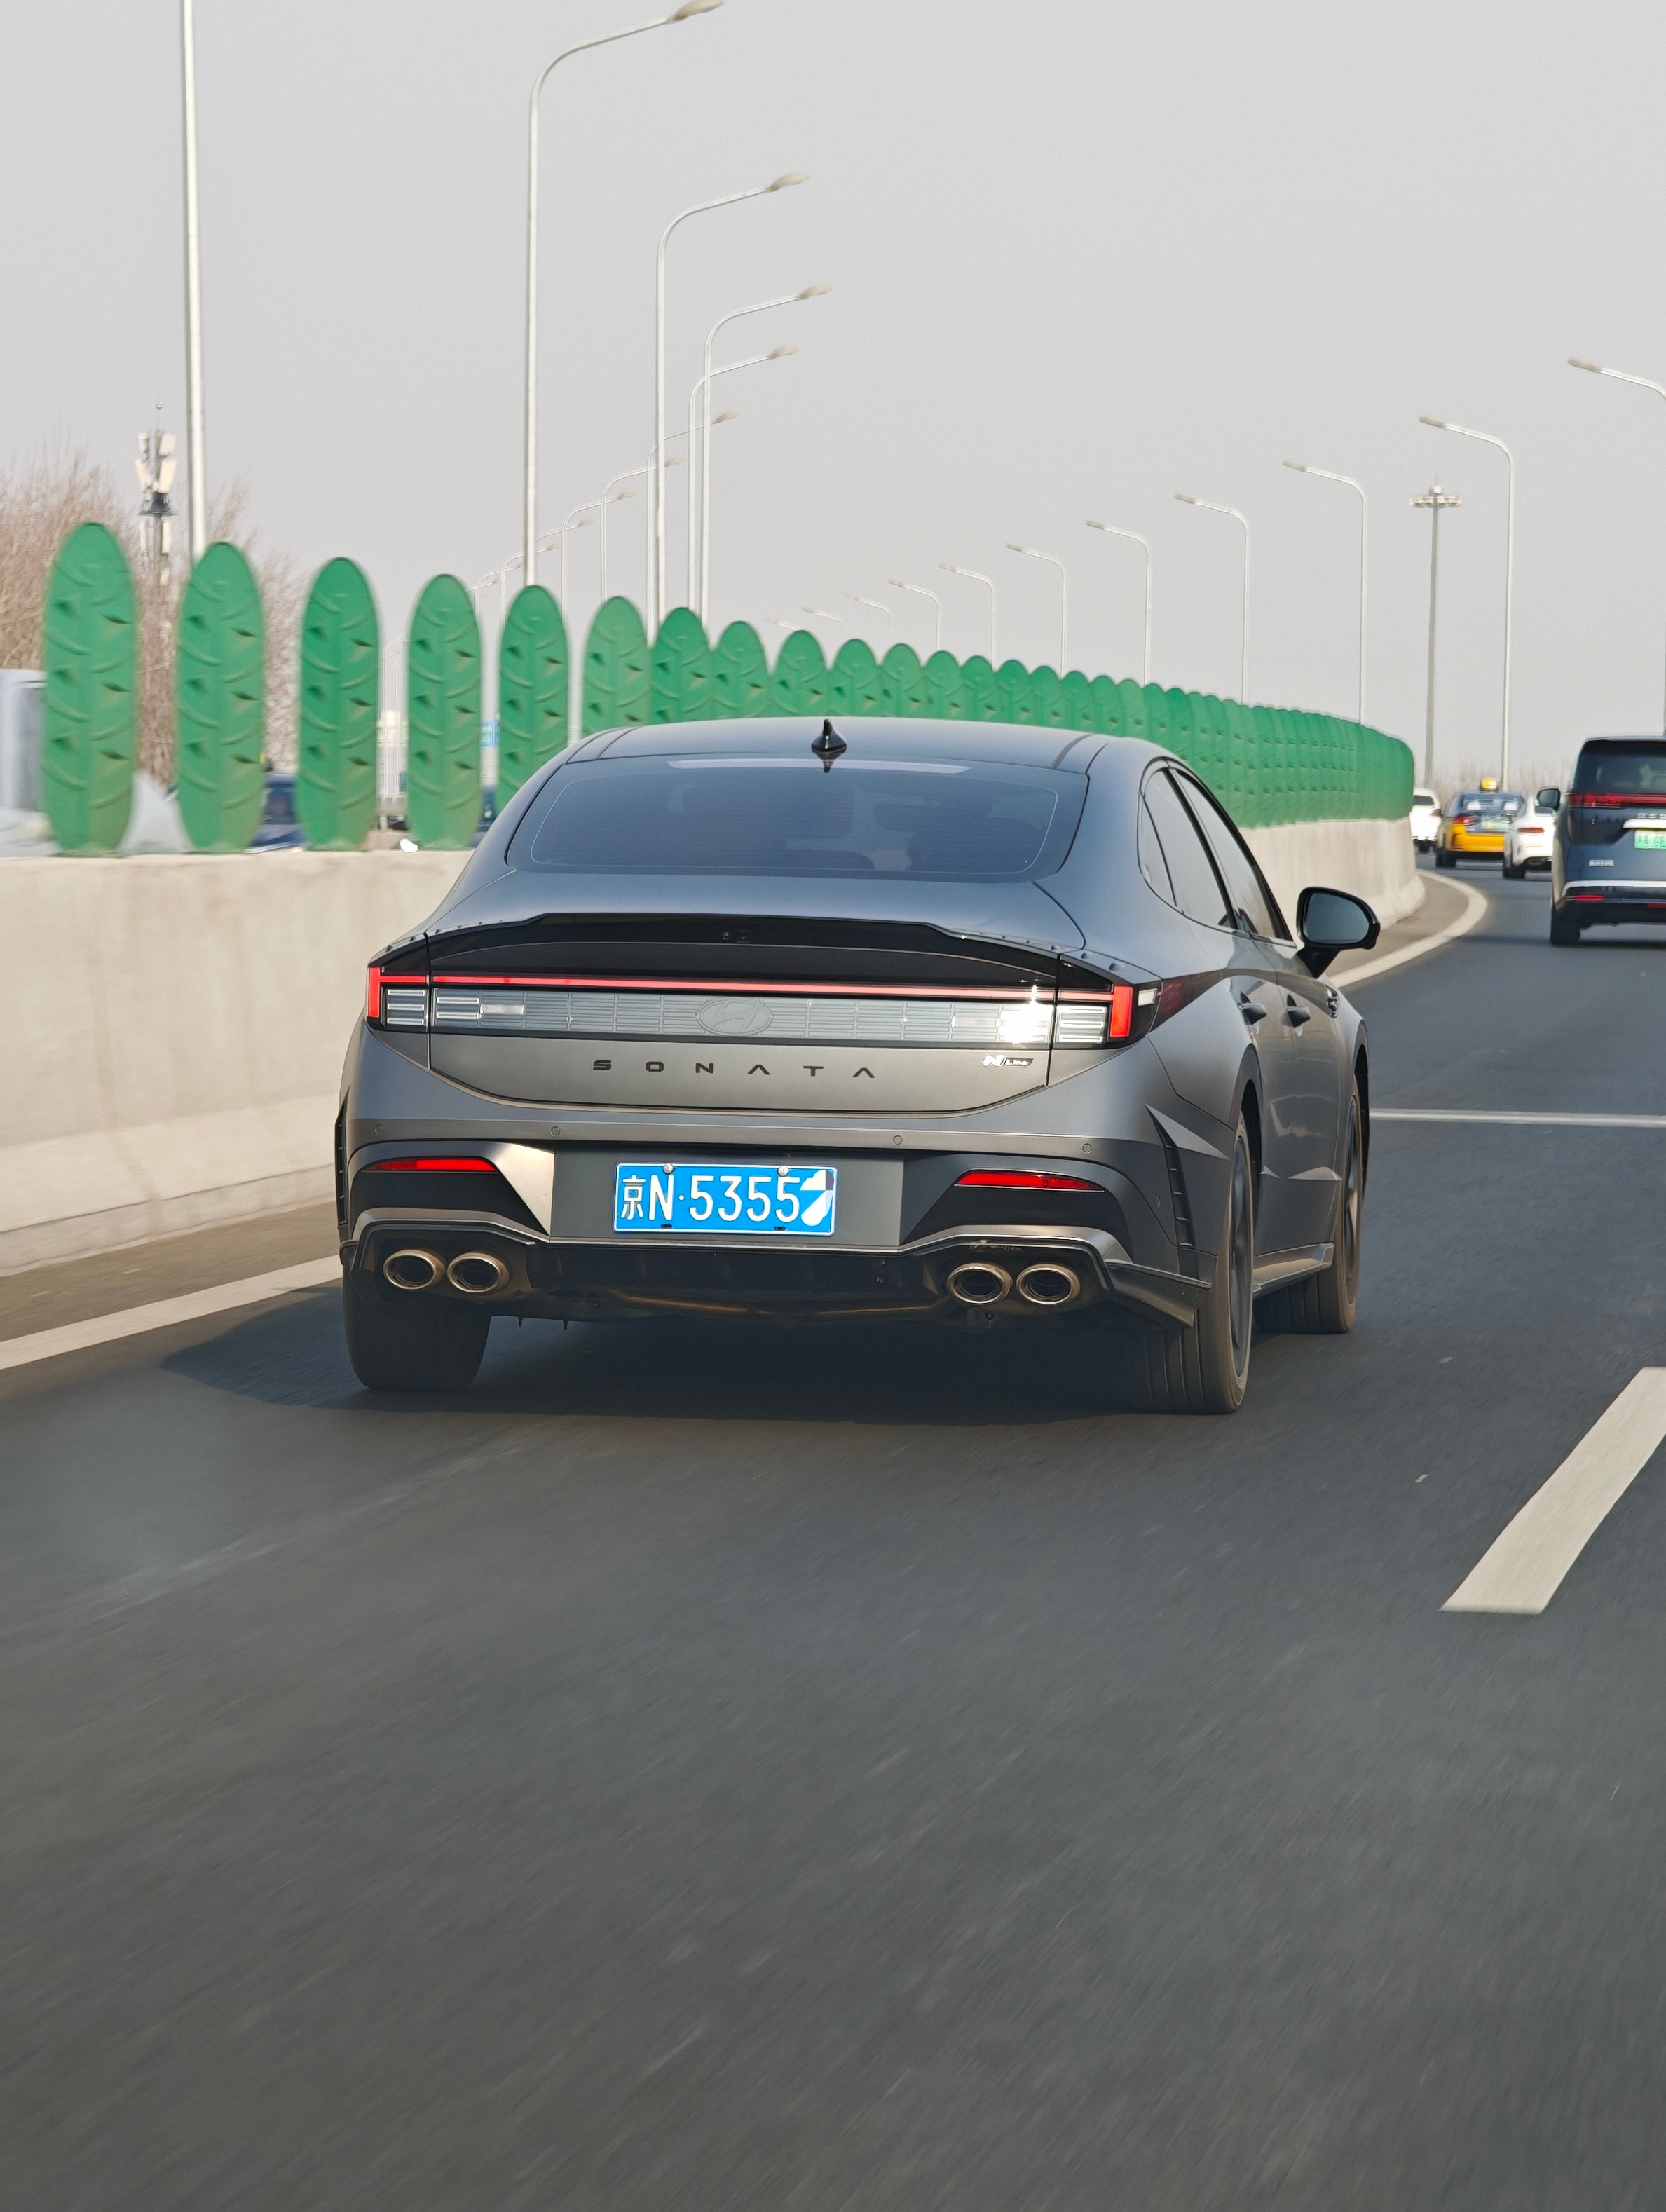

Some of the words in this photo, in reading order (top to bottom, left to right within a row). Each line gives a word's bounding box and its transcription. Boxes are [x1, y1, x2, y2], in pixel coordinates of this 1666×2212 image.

[592, 1059, 875, 1079] SONATA
[982, 1054, 1005, 1067] N
[620, 1174, 801, 1223] 京N·5355
